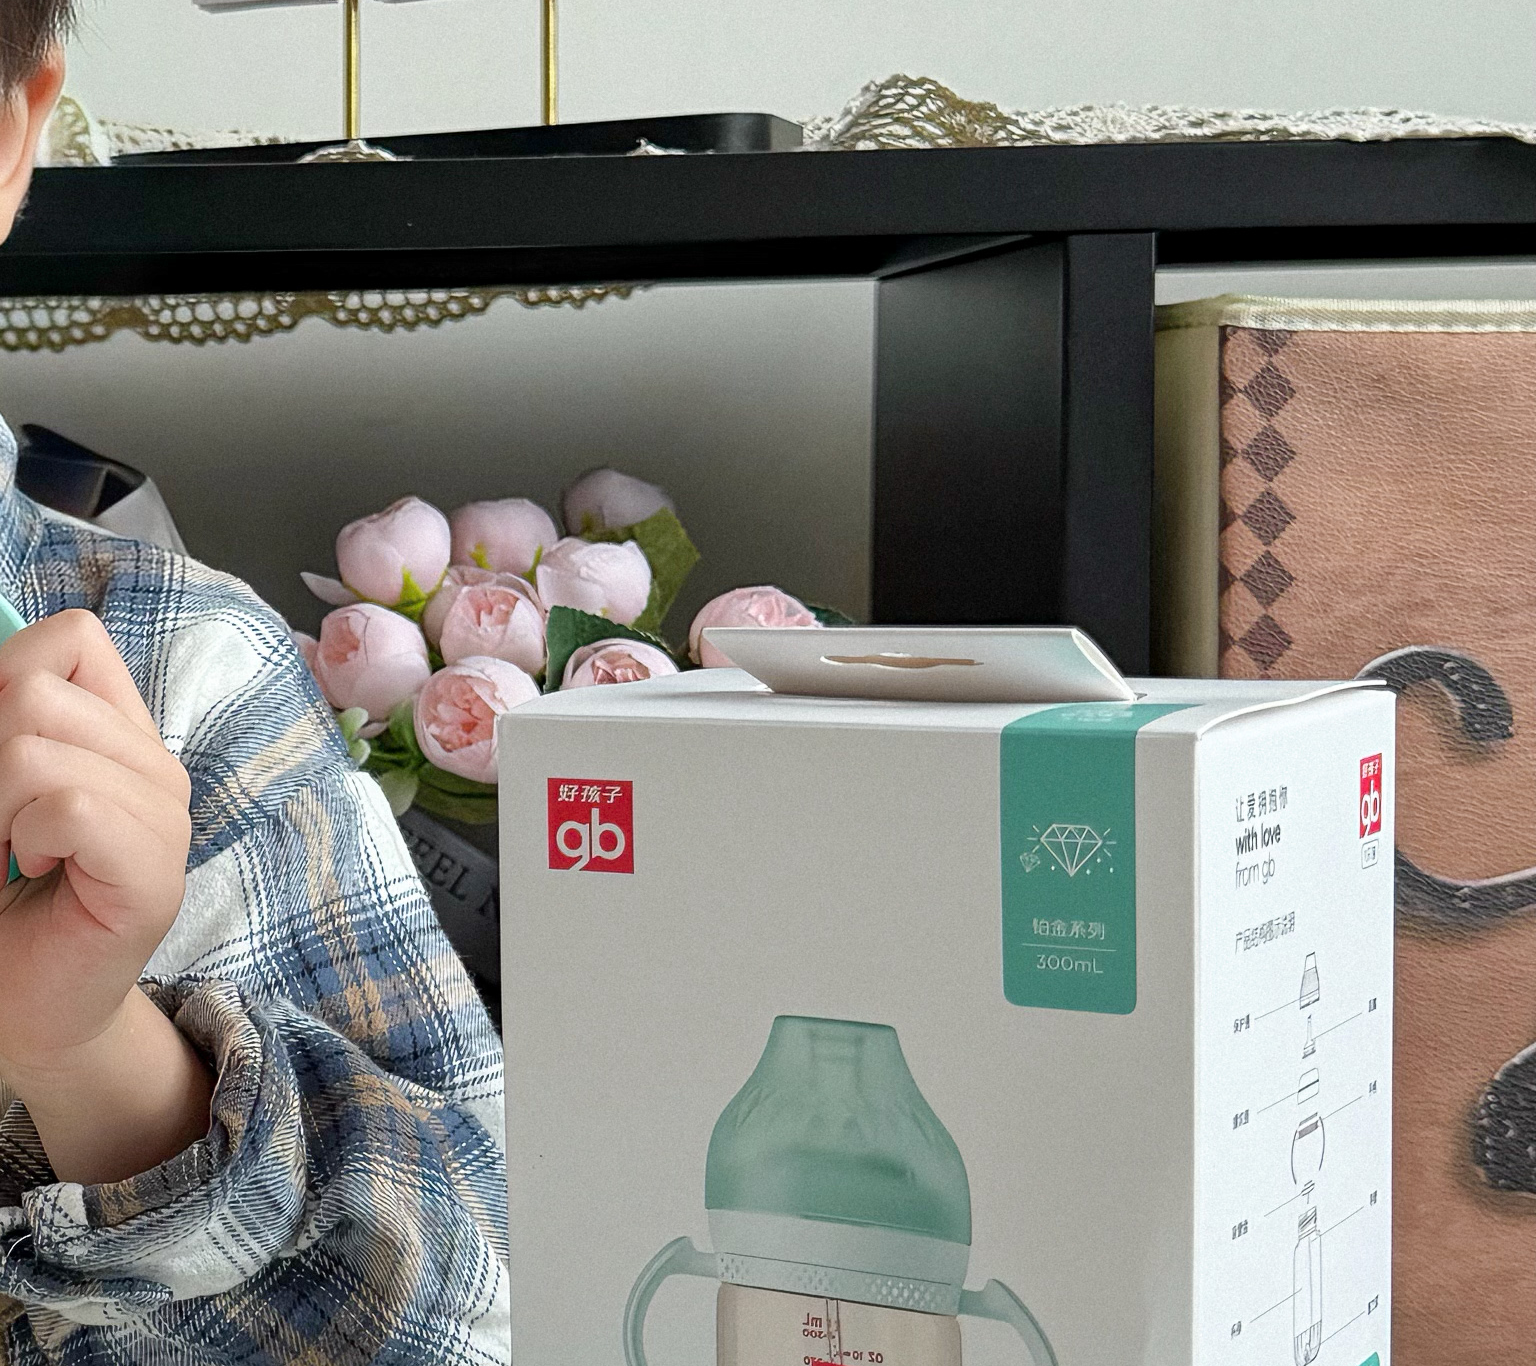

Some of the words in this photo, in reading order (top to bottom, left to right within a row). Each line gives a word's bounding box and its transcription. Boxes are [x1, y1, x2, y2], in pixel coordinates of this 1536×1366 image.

[557, 784, 623, 804] 好孩子
[1361, 779, 1380, 838] gb
[556, 807, 626, 872] gb
[1235, 825, 1258, 856] with
[1260, 823, 1282, 849] love
[1234, 860, 1260, 889] from
[1261, 852, 1276, 885] gb
[1036, 954, 1104, 974] 300mL
